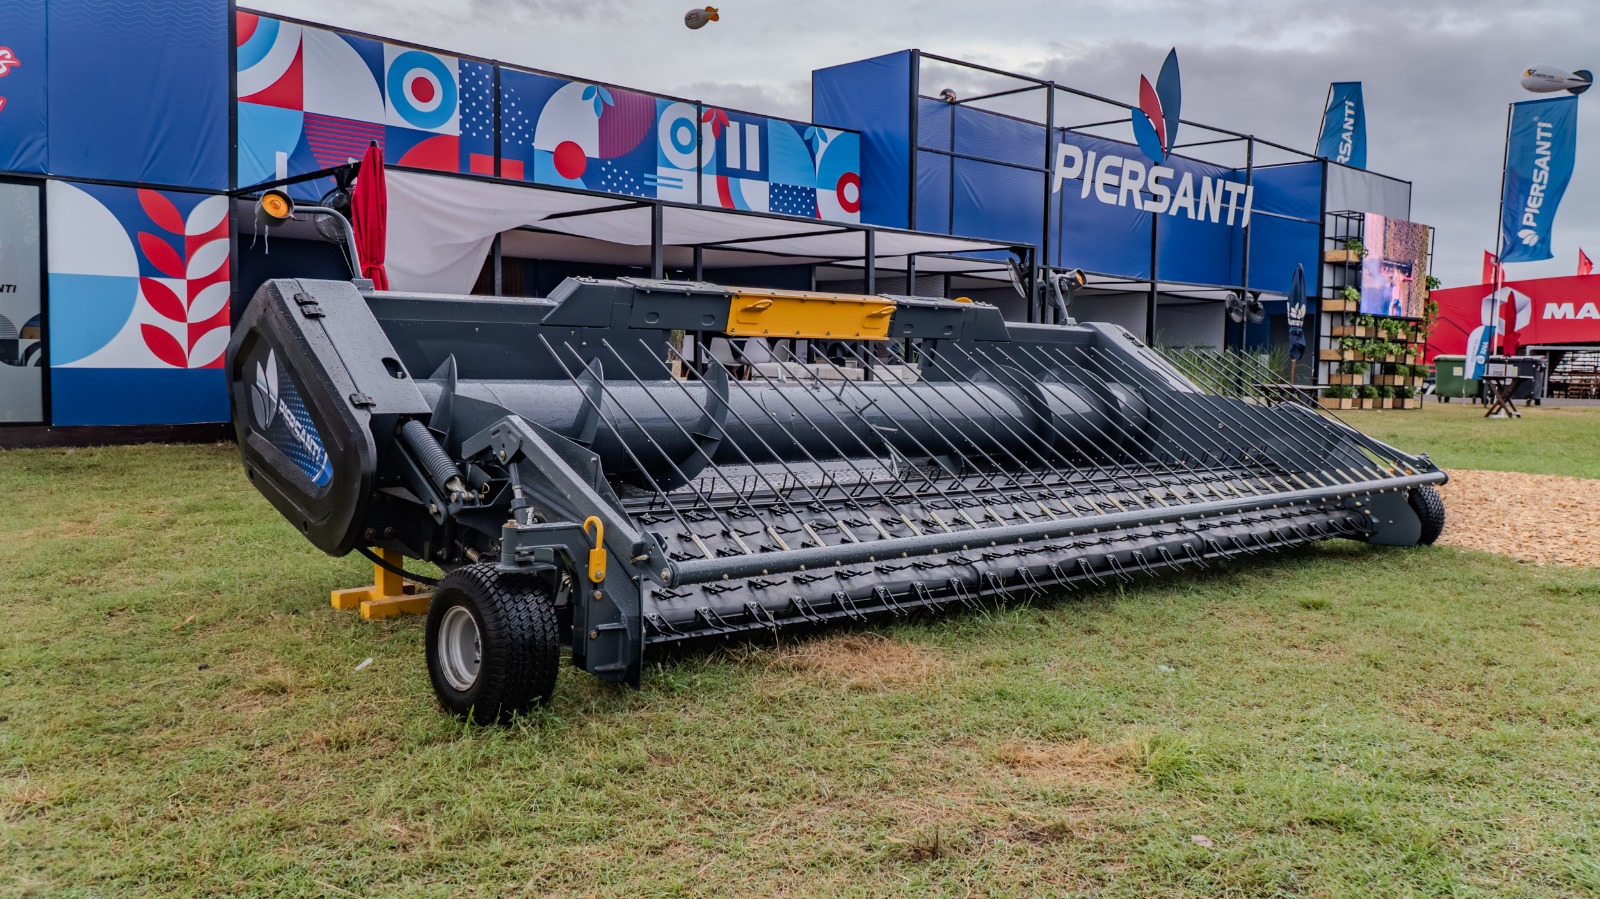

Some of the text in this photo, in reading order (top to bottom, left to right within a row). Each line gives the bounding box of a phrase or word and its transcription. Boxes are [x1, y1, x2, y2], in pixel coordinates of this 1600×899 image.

[1052, 143, 1254, 228] PIERSANTI
[1522, 121, 1553, 227] PIERSANTI
[1542, 302, 1600, 319] MA
[278, 398, 321, 459] PIERSANTI
